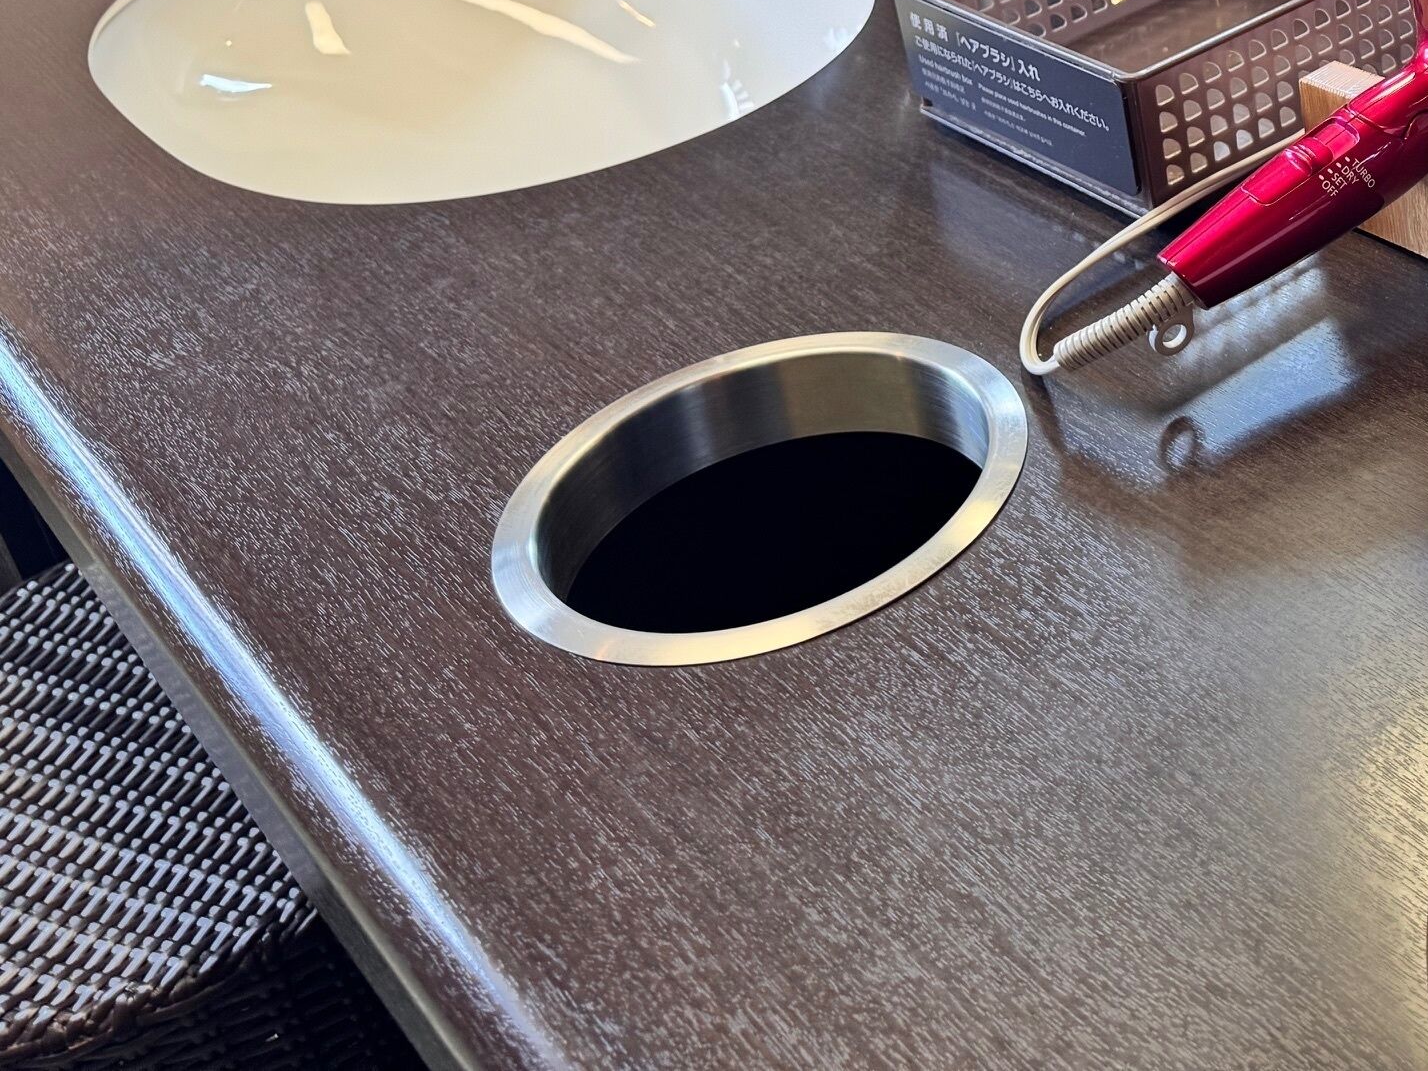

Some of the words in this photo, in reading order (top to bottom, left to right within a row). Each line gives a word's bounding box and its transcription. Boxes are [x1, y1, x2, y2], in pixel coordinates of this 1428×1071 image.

[1331, 172, 1348, 189] SET
[1341, 165, 1360, 184] DRY
[1352, 158, 1376, 188] TURBO
[1321, 180, 1339, 197] OFF
